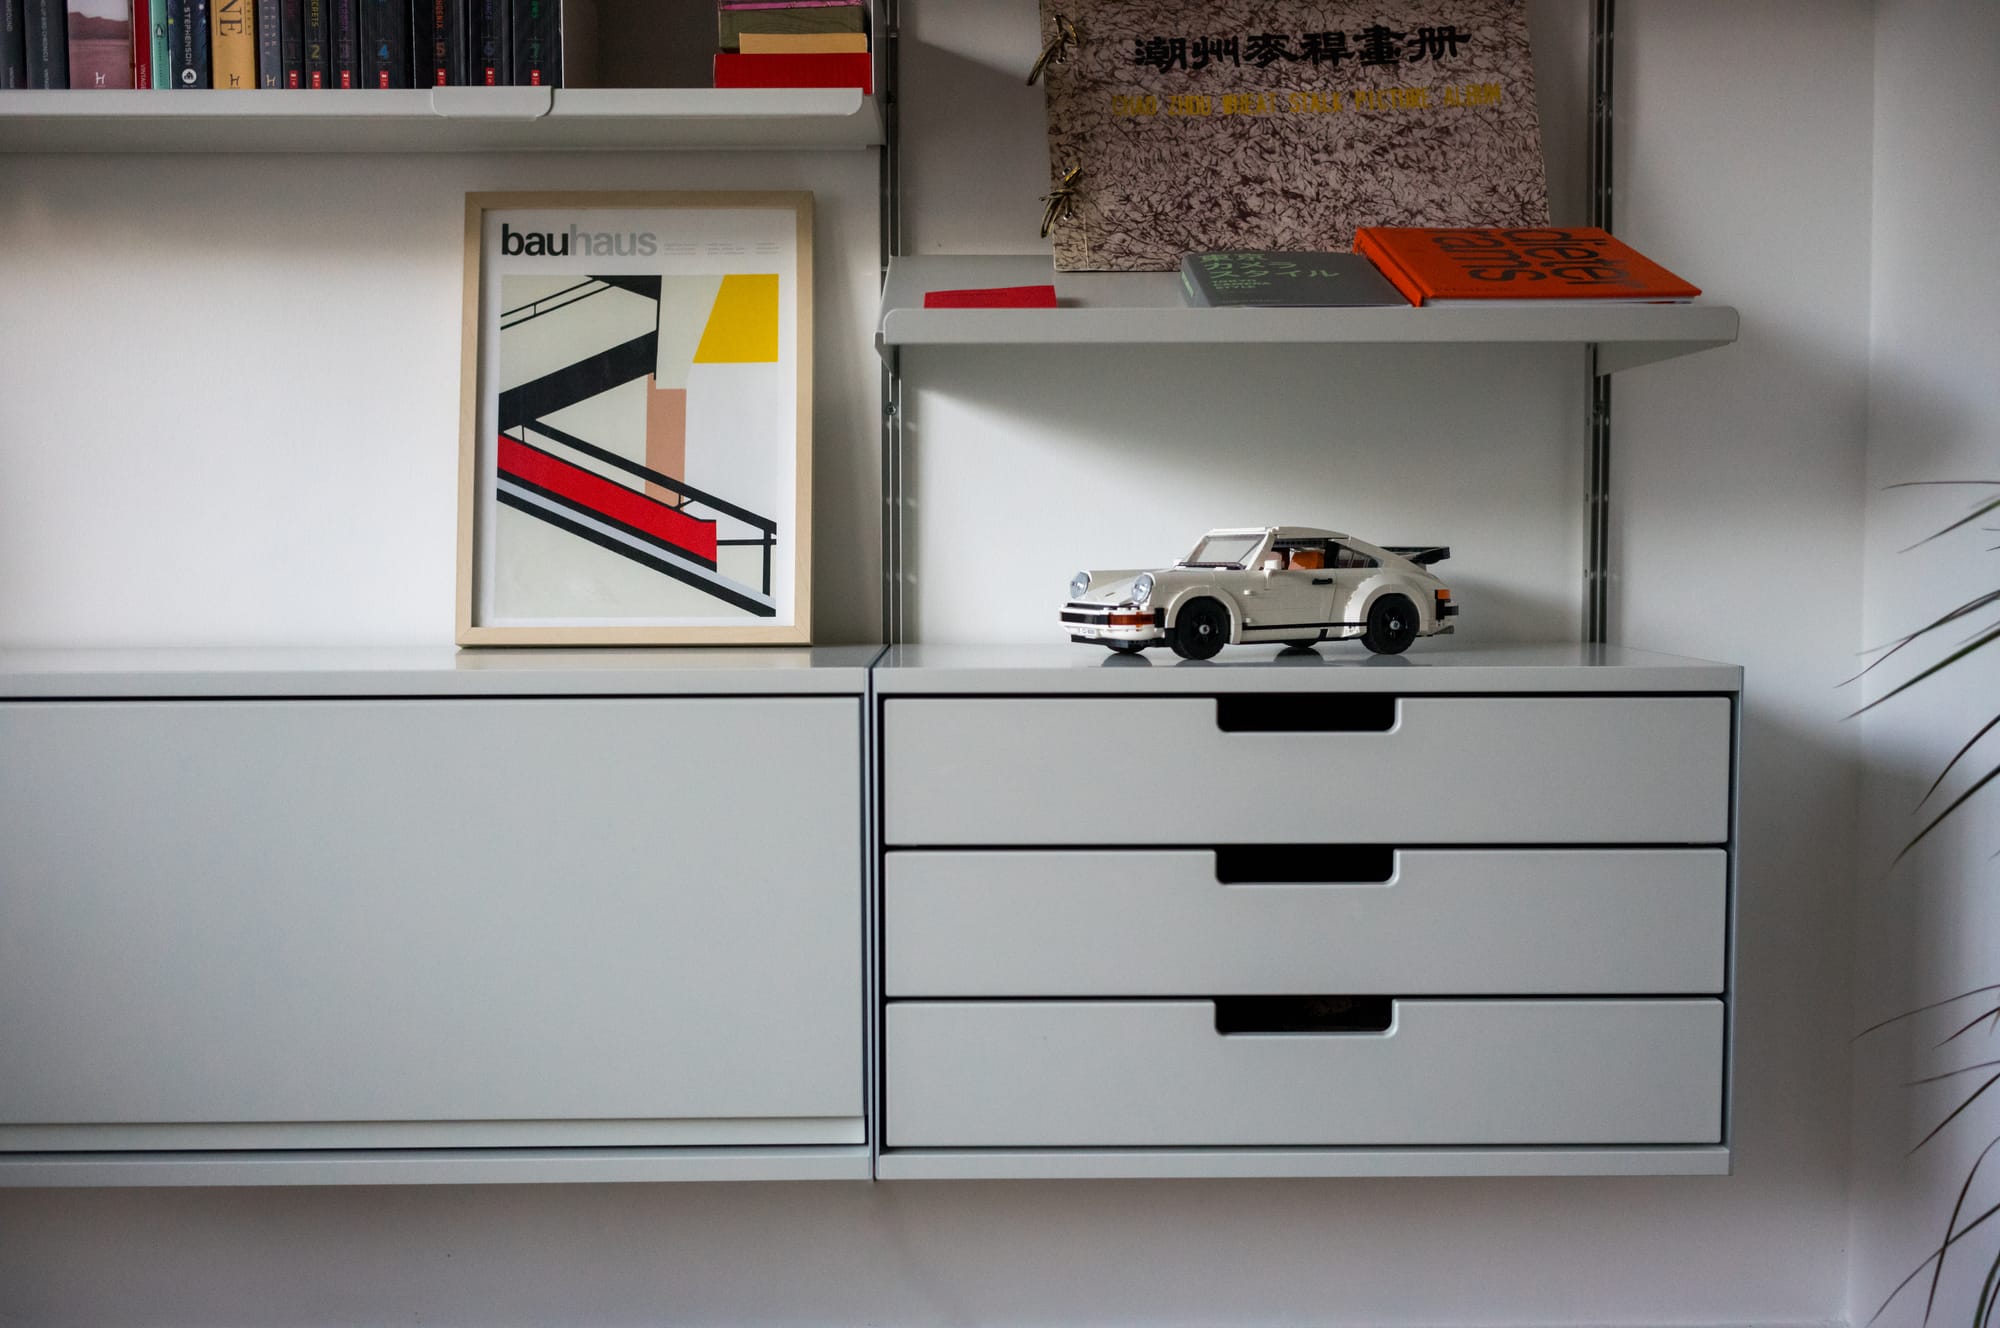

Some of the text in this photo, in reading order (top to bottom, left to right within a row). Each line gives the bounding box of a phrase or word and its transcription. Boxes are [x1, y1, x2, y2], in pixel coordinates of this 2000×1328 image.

[183, 7, 192, 65] STEPHENSON
[311, 44, 320, 59] 2
[377, 44, 389, 59] 4
[1112, 81, 1501, 116] CHAO ZHOU WHEAT STALK PICTURE ALBUM
[501, 223, 657, 256] bauhaus
[1205, 261, 1297, 271] カメラ
[1501, 230, 1643, 288] dieter
[1210, 269, 1340, 279] スタイル
